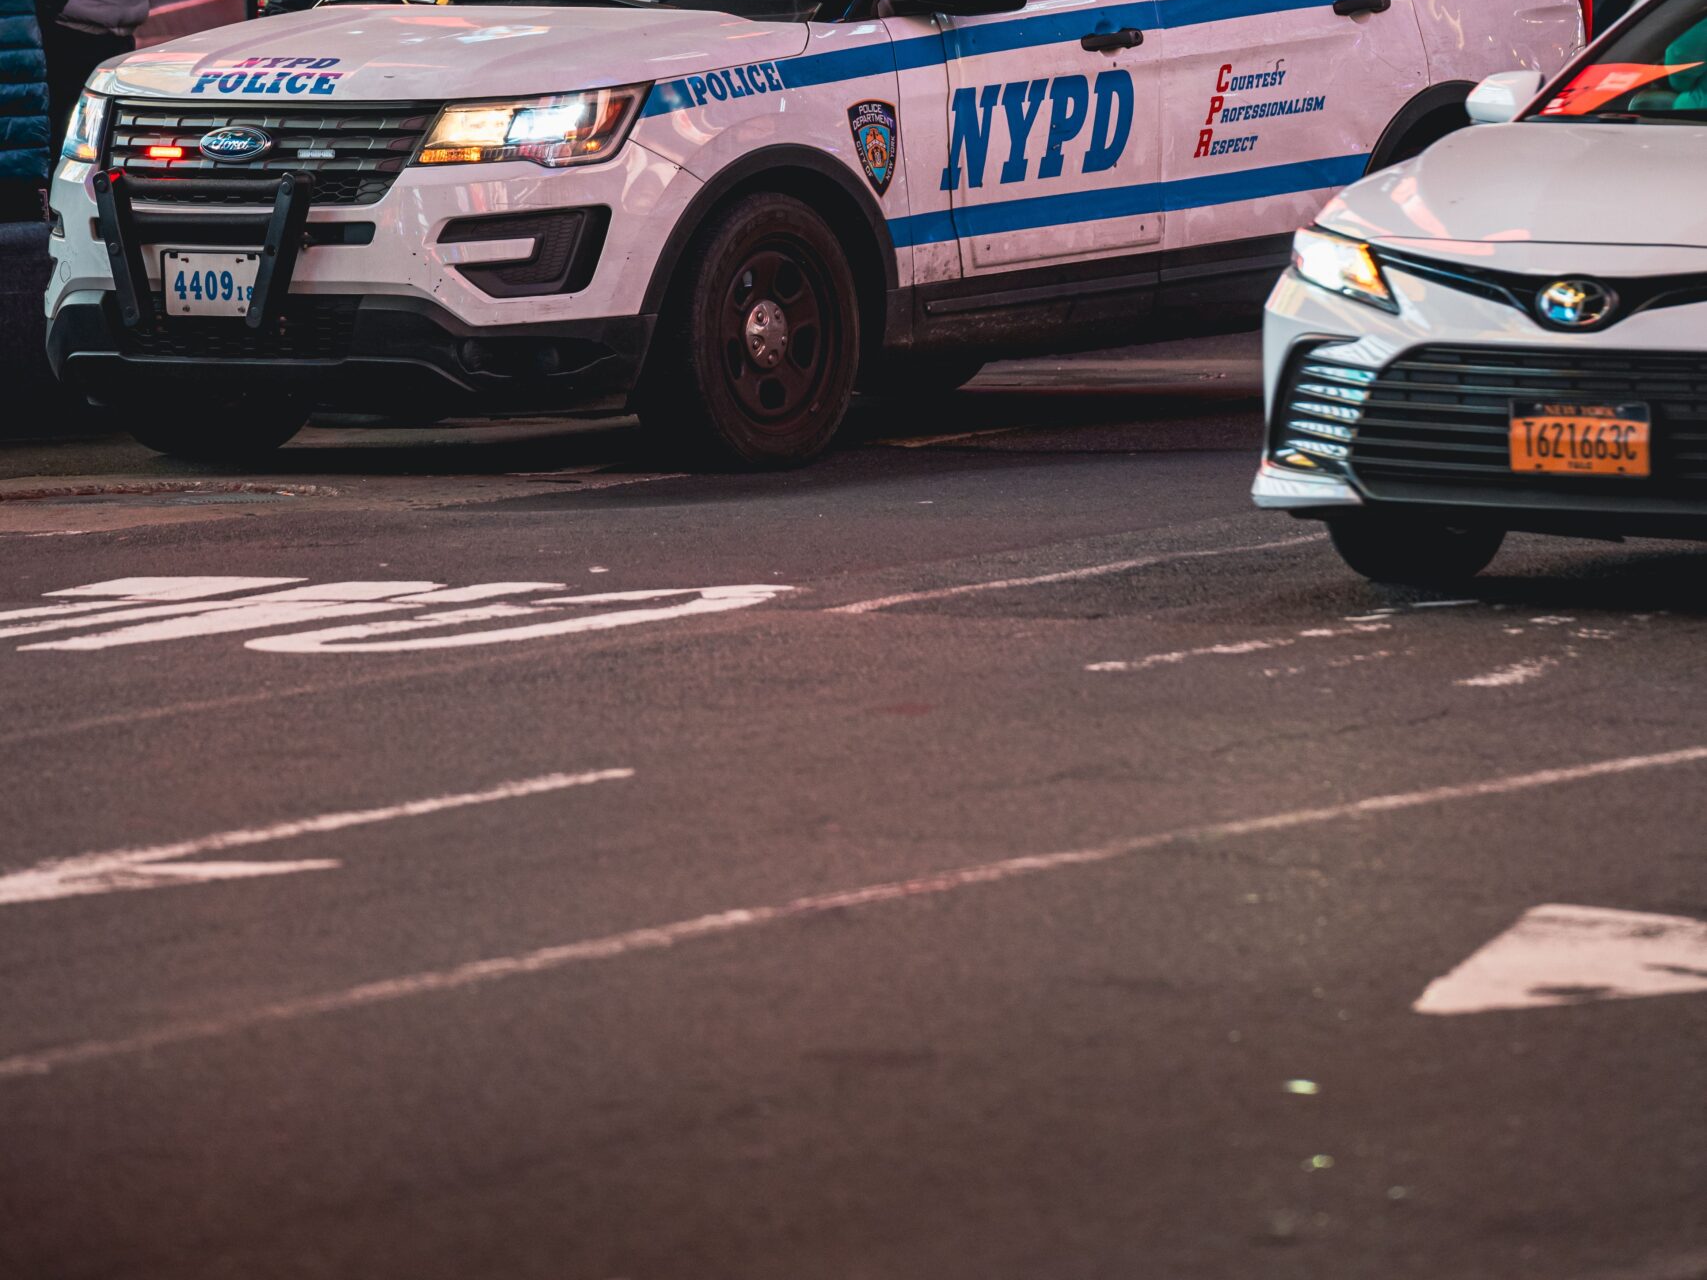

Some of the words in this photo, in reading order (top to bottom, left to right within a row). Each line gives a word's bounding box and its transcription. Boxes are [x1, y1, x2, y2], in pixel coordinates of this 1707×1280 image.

[233, 57, 340, 69] NYPD
[191, 71, 344, 95] POLICE
[687, 62, 783, 106] POLICE
[858, 103, 883, 115] POLICE
[852, 113, 894, 130] DEPARTMENT
[940, 69, 1134, 190] NYPD
[211, 131, 252, 150] Ford
[856, 140, 867, 163] CITY
[865, 165, 874, 178] OF
[1523, 421, 1637, 460] T621663C
